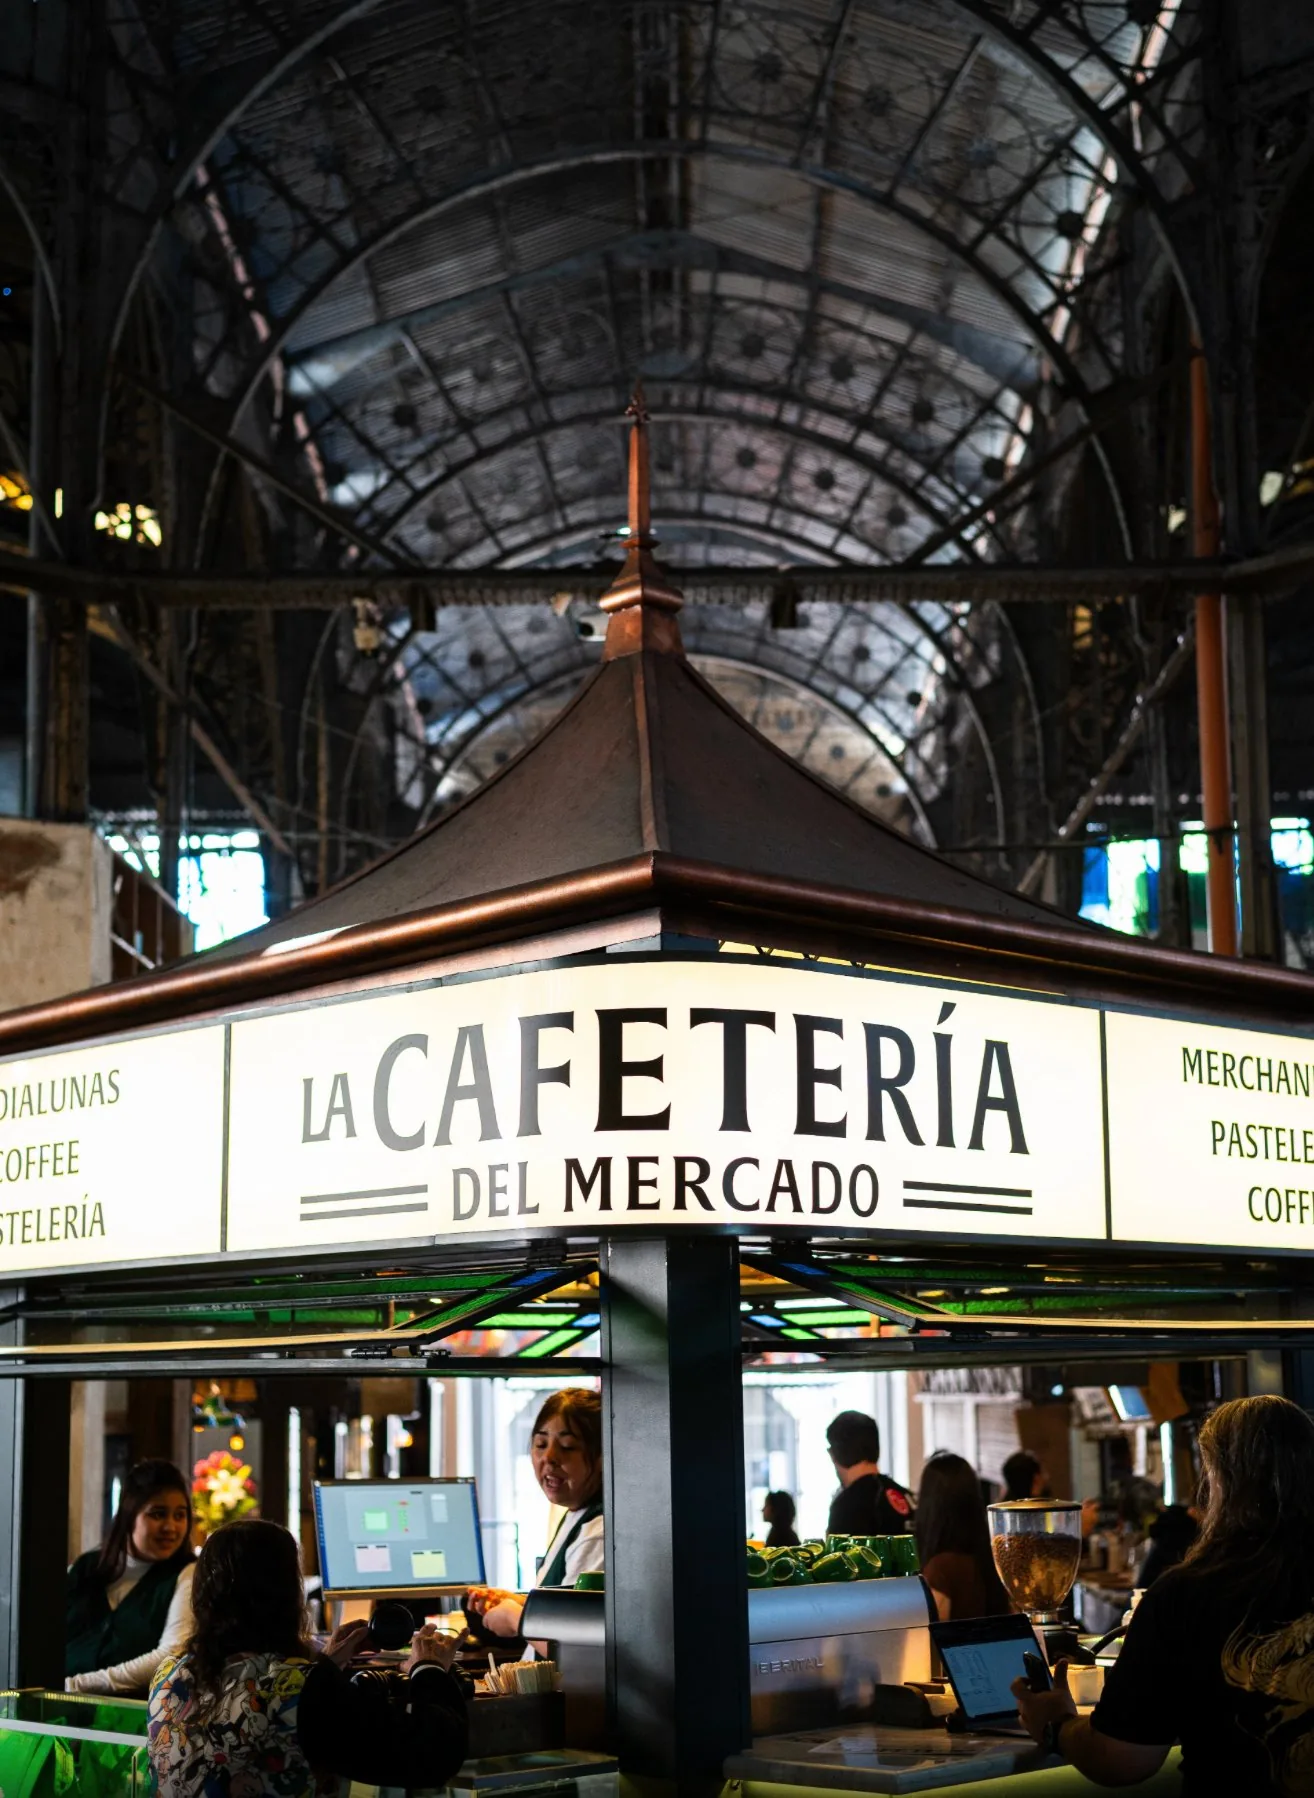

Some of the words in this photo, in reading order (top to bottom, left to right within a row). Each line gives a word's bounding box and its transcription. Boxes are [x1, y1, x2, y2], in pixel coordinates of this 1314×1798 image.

[301, 1072, 357, 1144] LA
[373, 1000, 1030, 1156] CAFETERÍA
[1181, 1046, 1314, 1098] MERCHAN
[0, 1139, 80, 1183] OFFEE
[452, 1160, 540, 1221] DEL
[563, 1155, 880, 1218] MERCADO
[1247, 1186, 1314, 1225] COFF
[0, 1192, 106, 1245] TELERÍA
